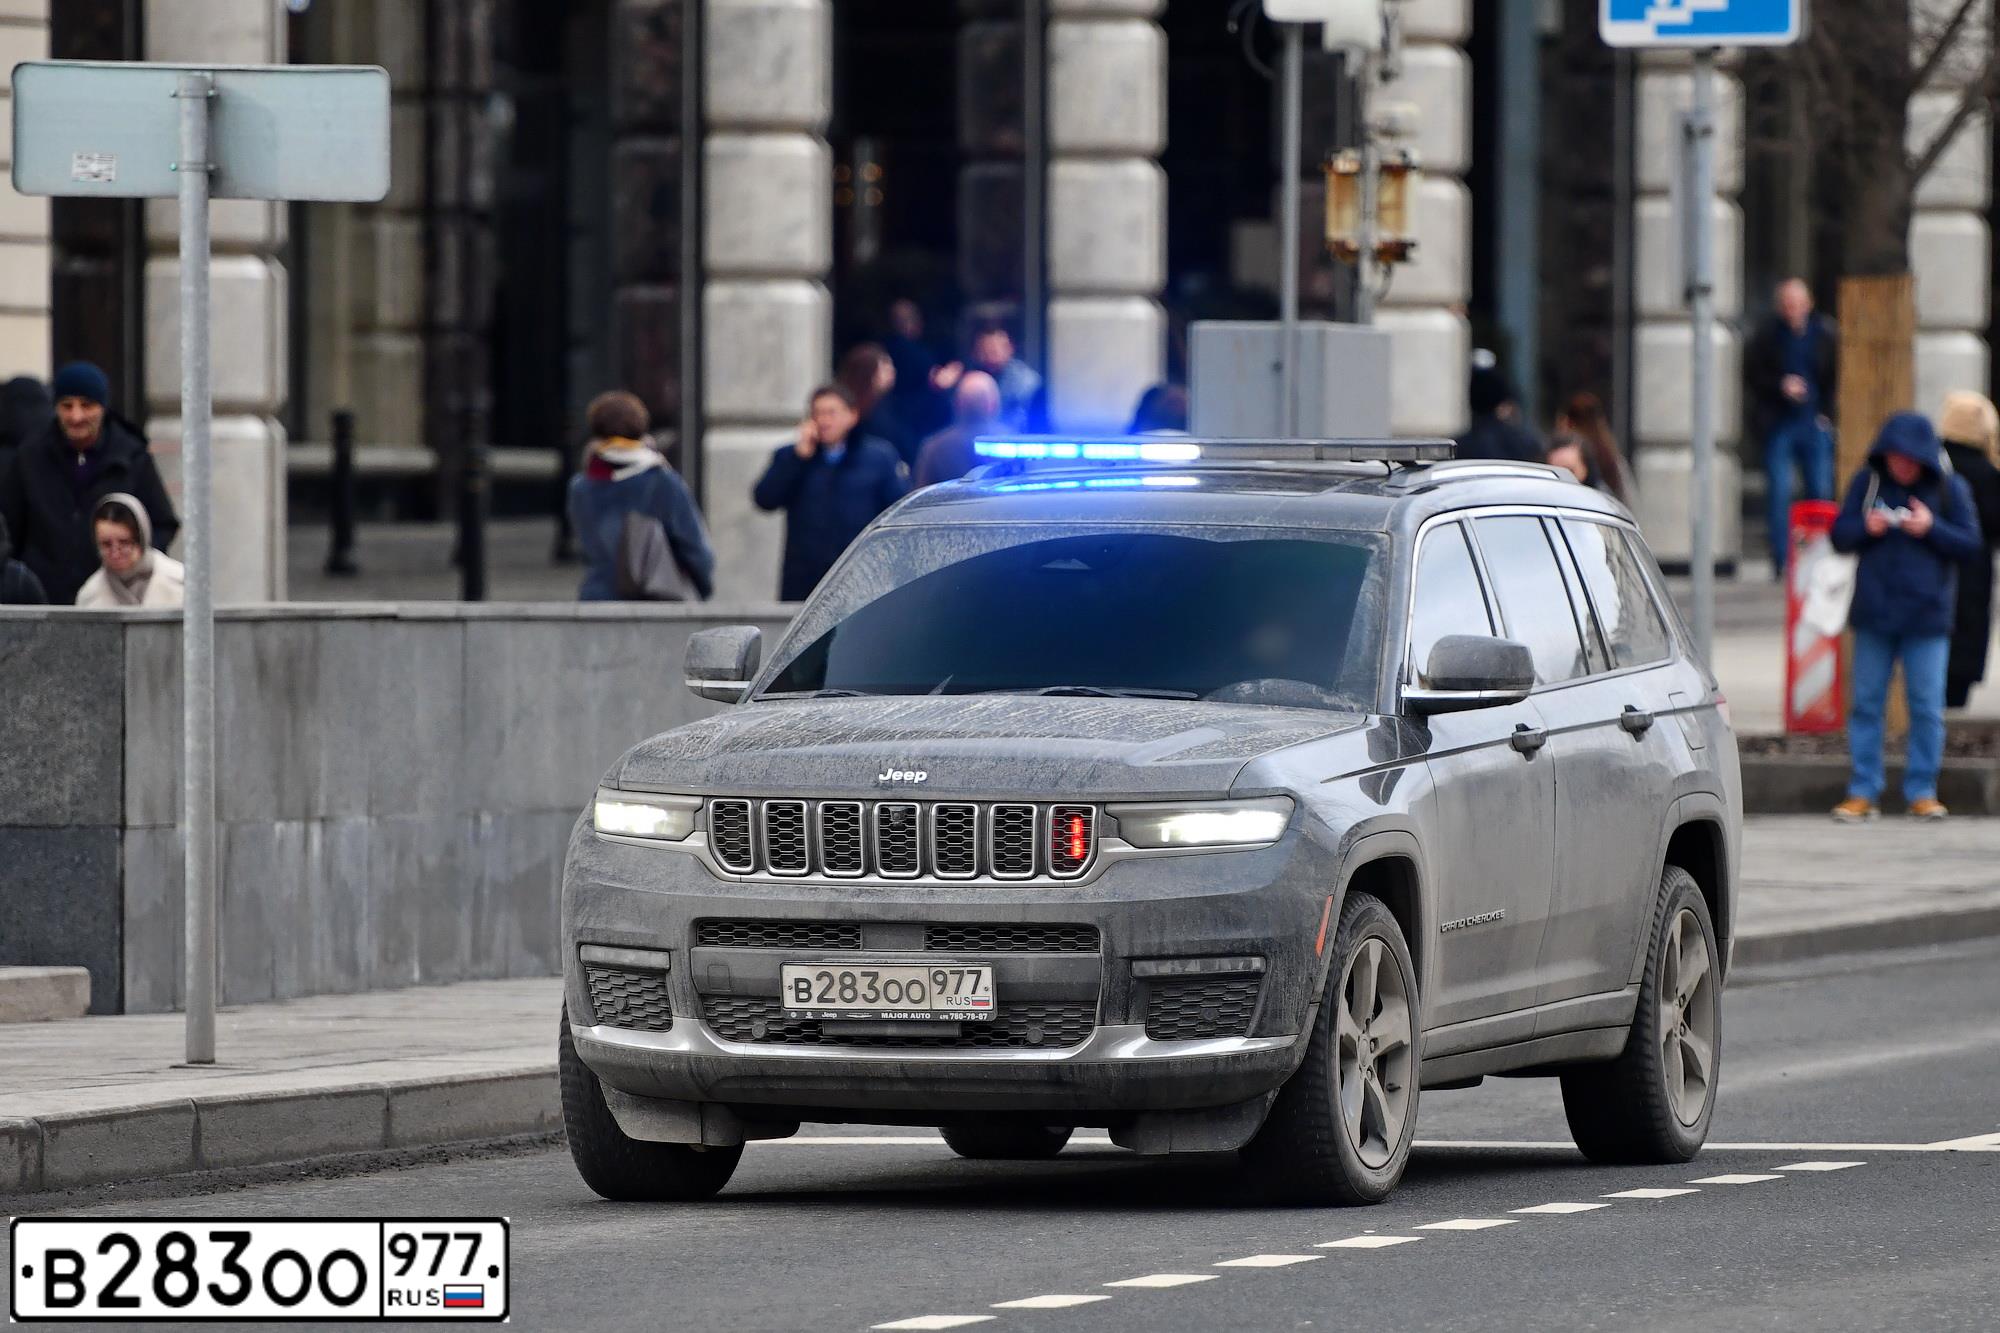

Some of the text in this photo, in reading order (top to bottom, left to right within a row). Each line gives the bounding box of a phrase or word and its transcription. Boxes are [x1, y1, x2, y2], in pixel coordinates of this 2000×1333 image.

[879, 768, 928, 784] Jeep
[1440, 909, 1505, 933] GRAND CHEROKEE
[932, 970, 982, 995] 977
[946, 996, 971, 1006] RUS
[821, 1011, 838, 1019] Jeep
